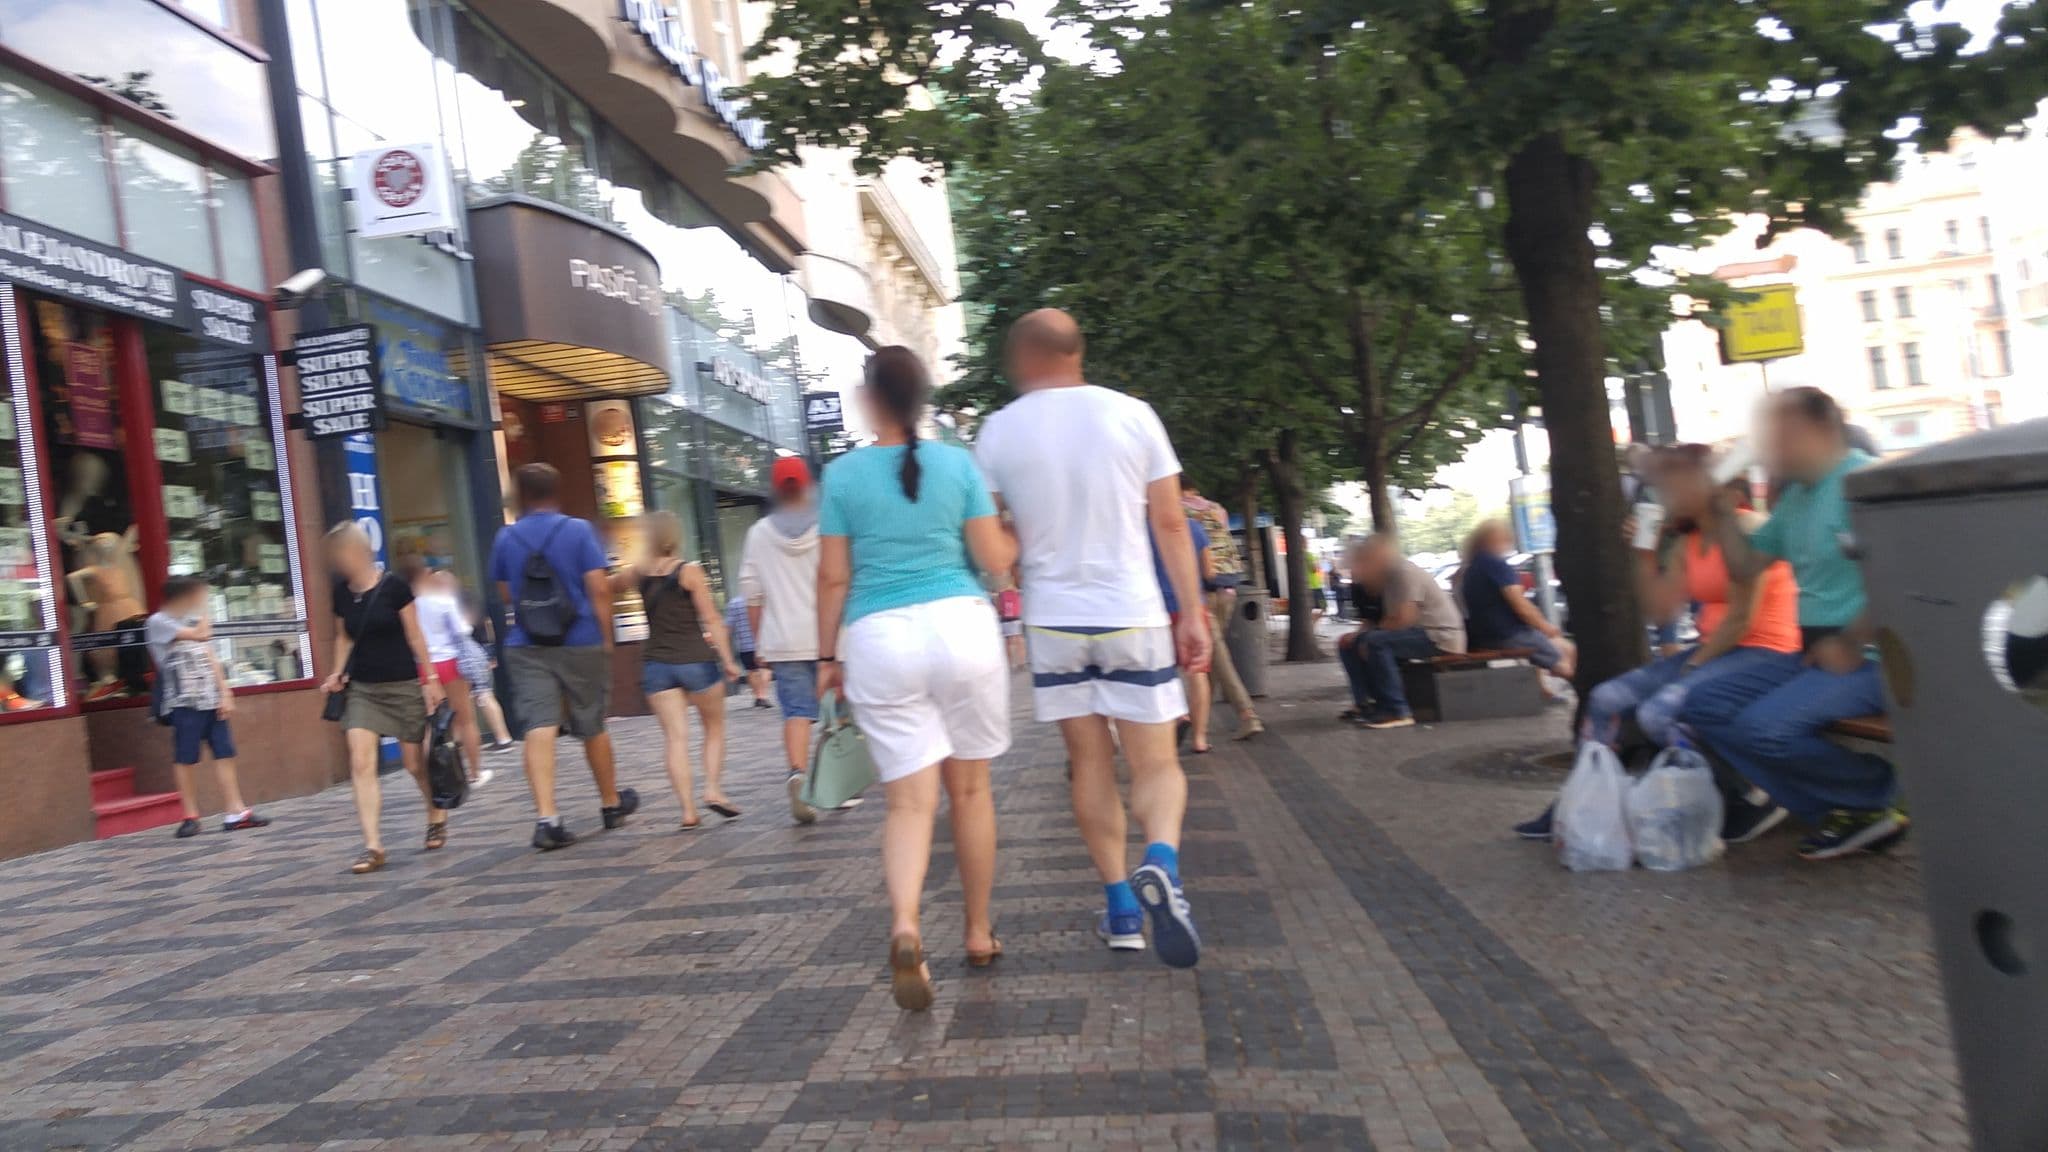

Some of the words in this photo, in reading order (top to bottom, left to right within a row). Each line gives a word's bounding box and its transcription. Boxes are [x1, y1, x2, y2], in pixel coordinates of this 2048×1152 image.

[191, 289, 256, 322] SUPER
[202, 316, 253, 344] SALE
[297, 350, 372, 375] SUPER
[301, 368, 374, 393] SLEVA
[302, 394, 377, 418] SUPER
[313, 412, 371, 435] SALE
